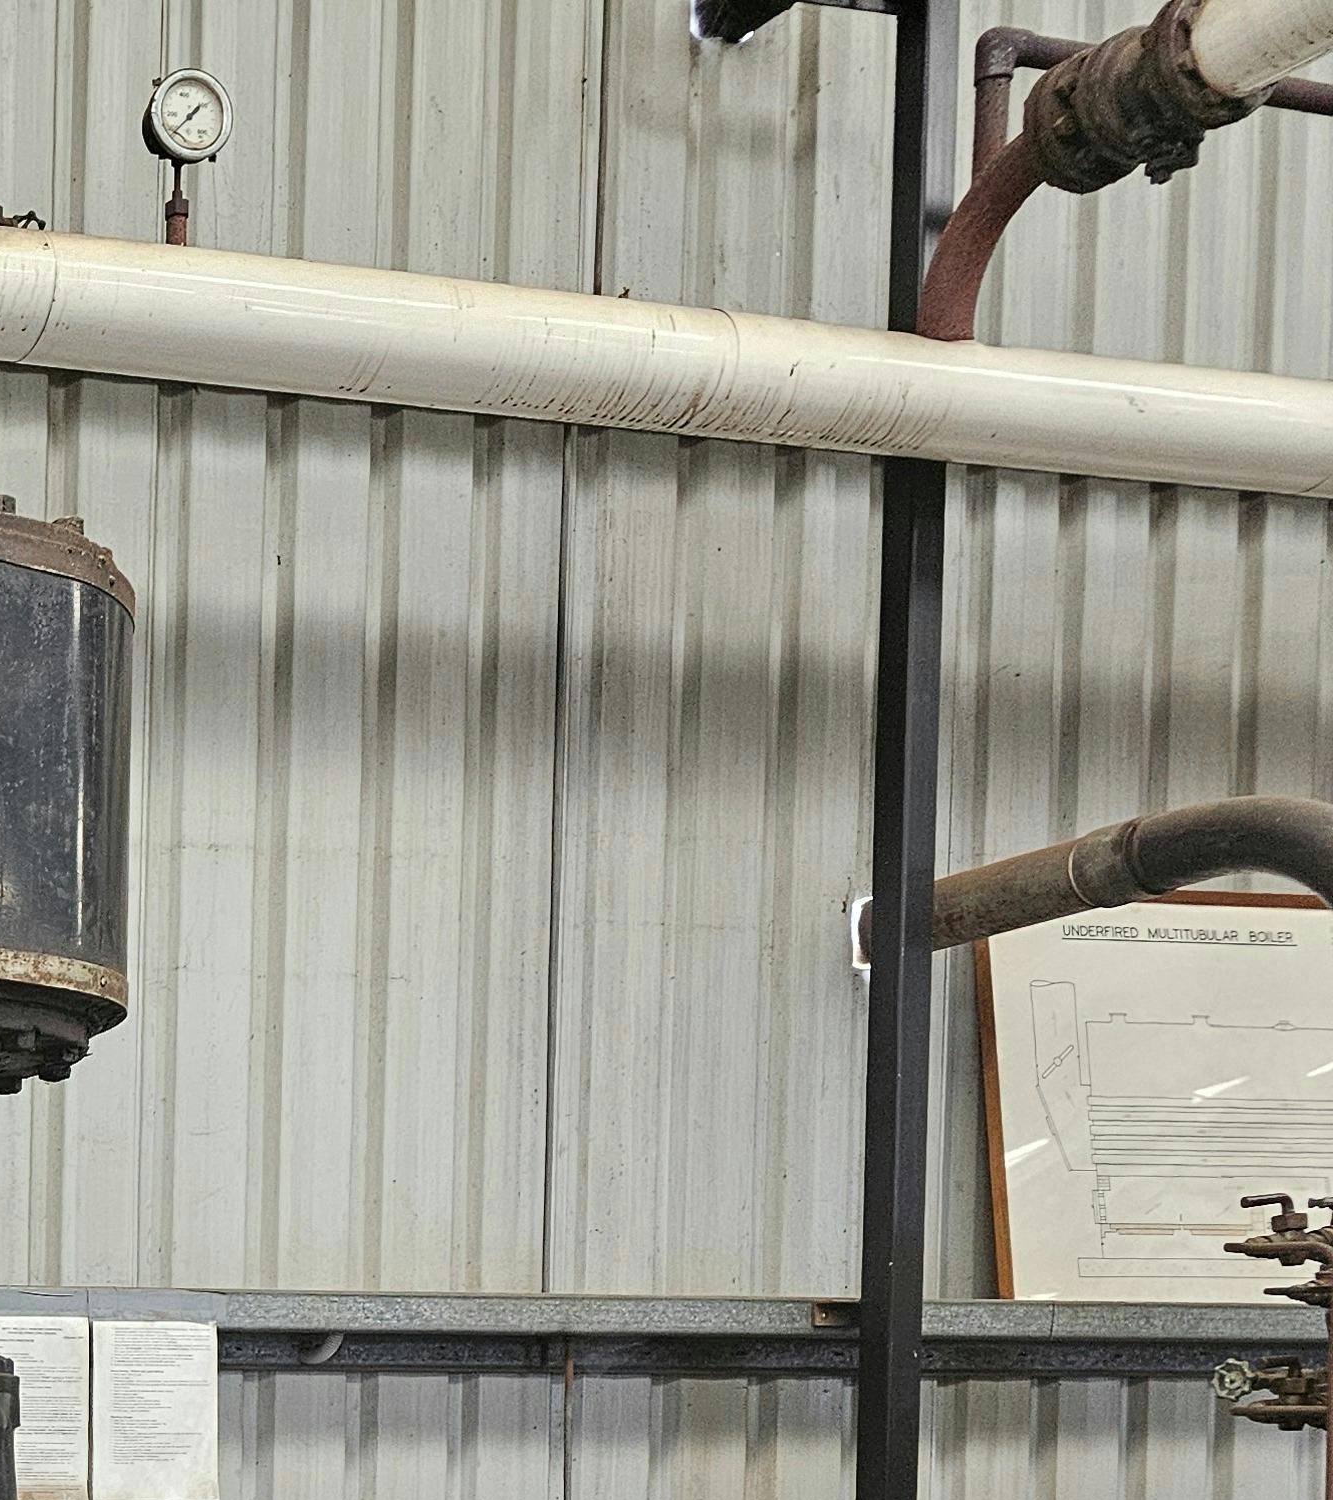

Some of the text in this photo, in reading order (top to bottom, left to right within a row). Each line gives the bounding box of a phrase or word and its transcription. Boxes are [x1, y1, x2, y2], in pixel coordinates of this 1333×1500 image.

[1062, 924, 1294, 943] UNDERFIRED MULTITUBULAR BOILER
